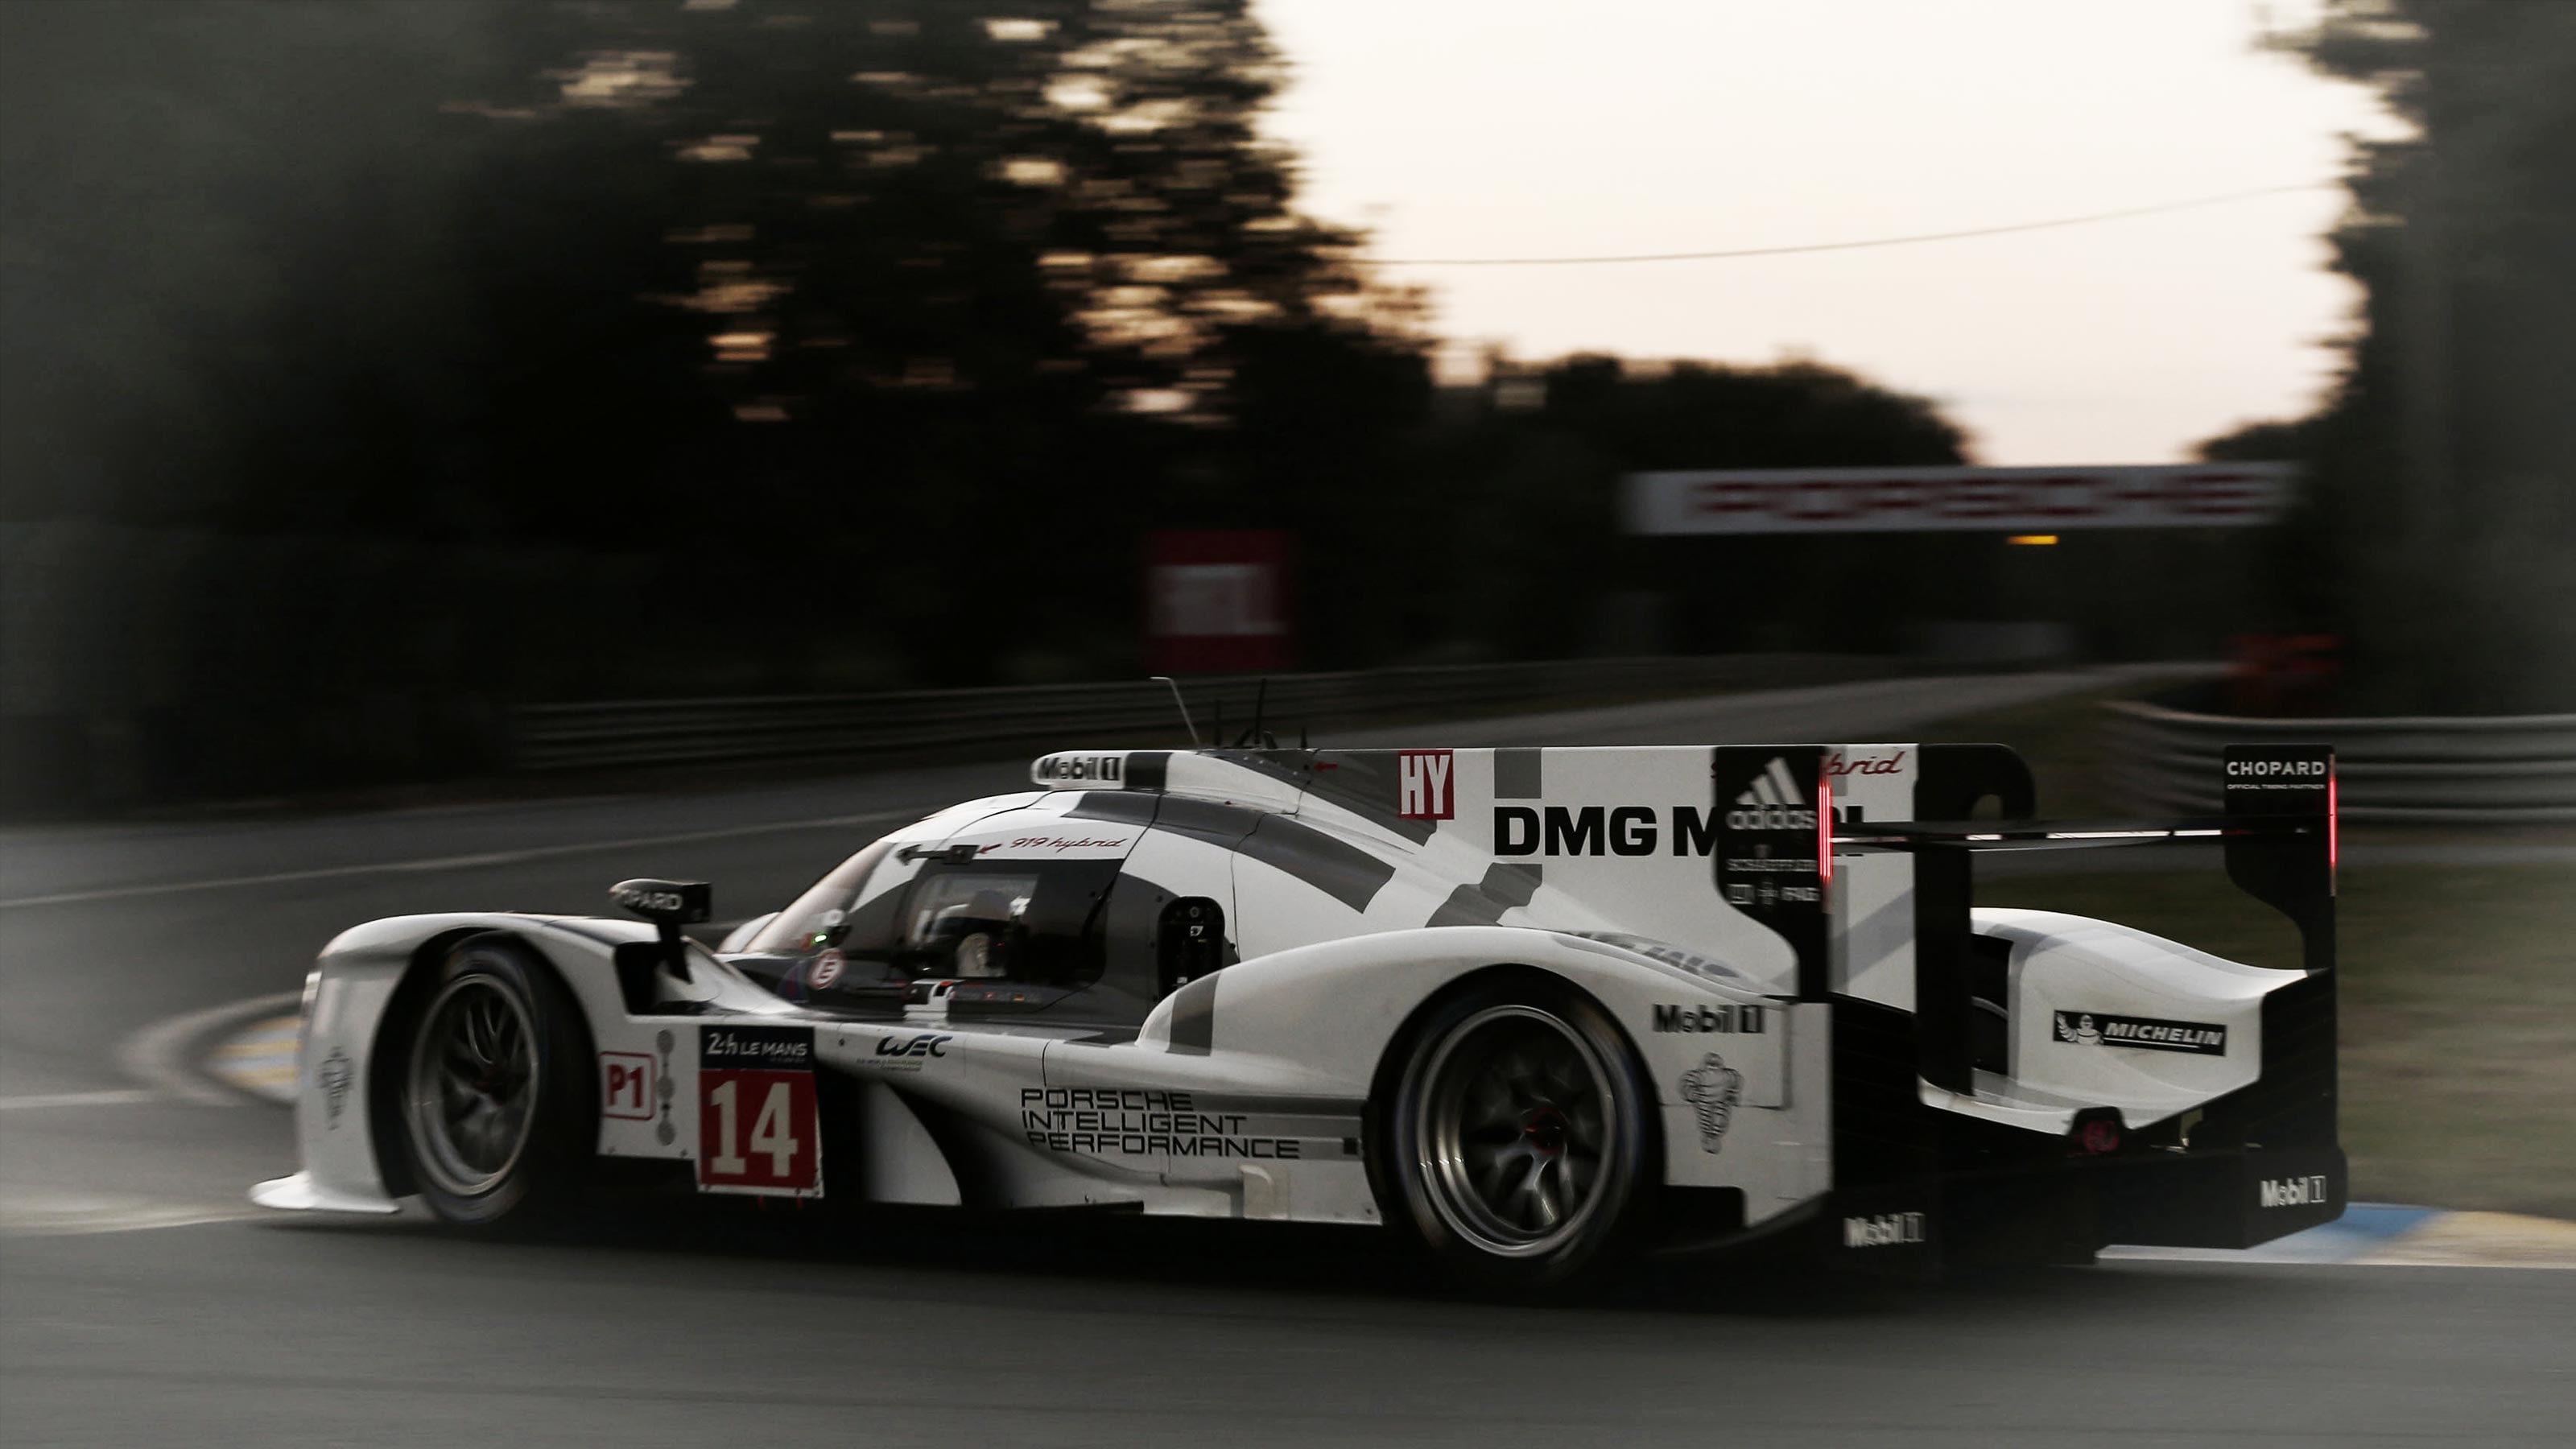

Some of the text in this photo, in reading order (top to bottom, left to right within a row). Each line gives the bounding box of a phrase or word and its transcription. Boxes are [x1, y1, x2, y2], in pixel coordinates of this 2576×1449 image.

[1038, 757, 1099, 779] Mobil
[2226, 761, 2326, 776] CHOPARD
[1400, 754, 1451, 815] HY
[1725, 805, 1818, 830] adidas
[1494, 806, 1657, 856] DMG
[1009, 837, 1129, 853] 919 hybrid
[1653, 1004, 1735, 1033] Mobil
[876, 1034, 953, 1057] WEC
[2103, 1022, 2224, 1046] MICHELIN
[761, 1041, 809, 1056] MANS
[607, 1064, 645, 1108] P1
[1022, 1088, 1194, 1111] PORSCHE
[710, 1080, 799, 1178] 14
[1022, 1111, 1247, 1135] INTELLIGENT
[1026, 1131, 1300, 1159] PERFORMANCE
[2260, 1178, 2310, 1208] Mobil
[1843, 1214, 1903, 1248] Mobil
